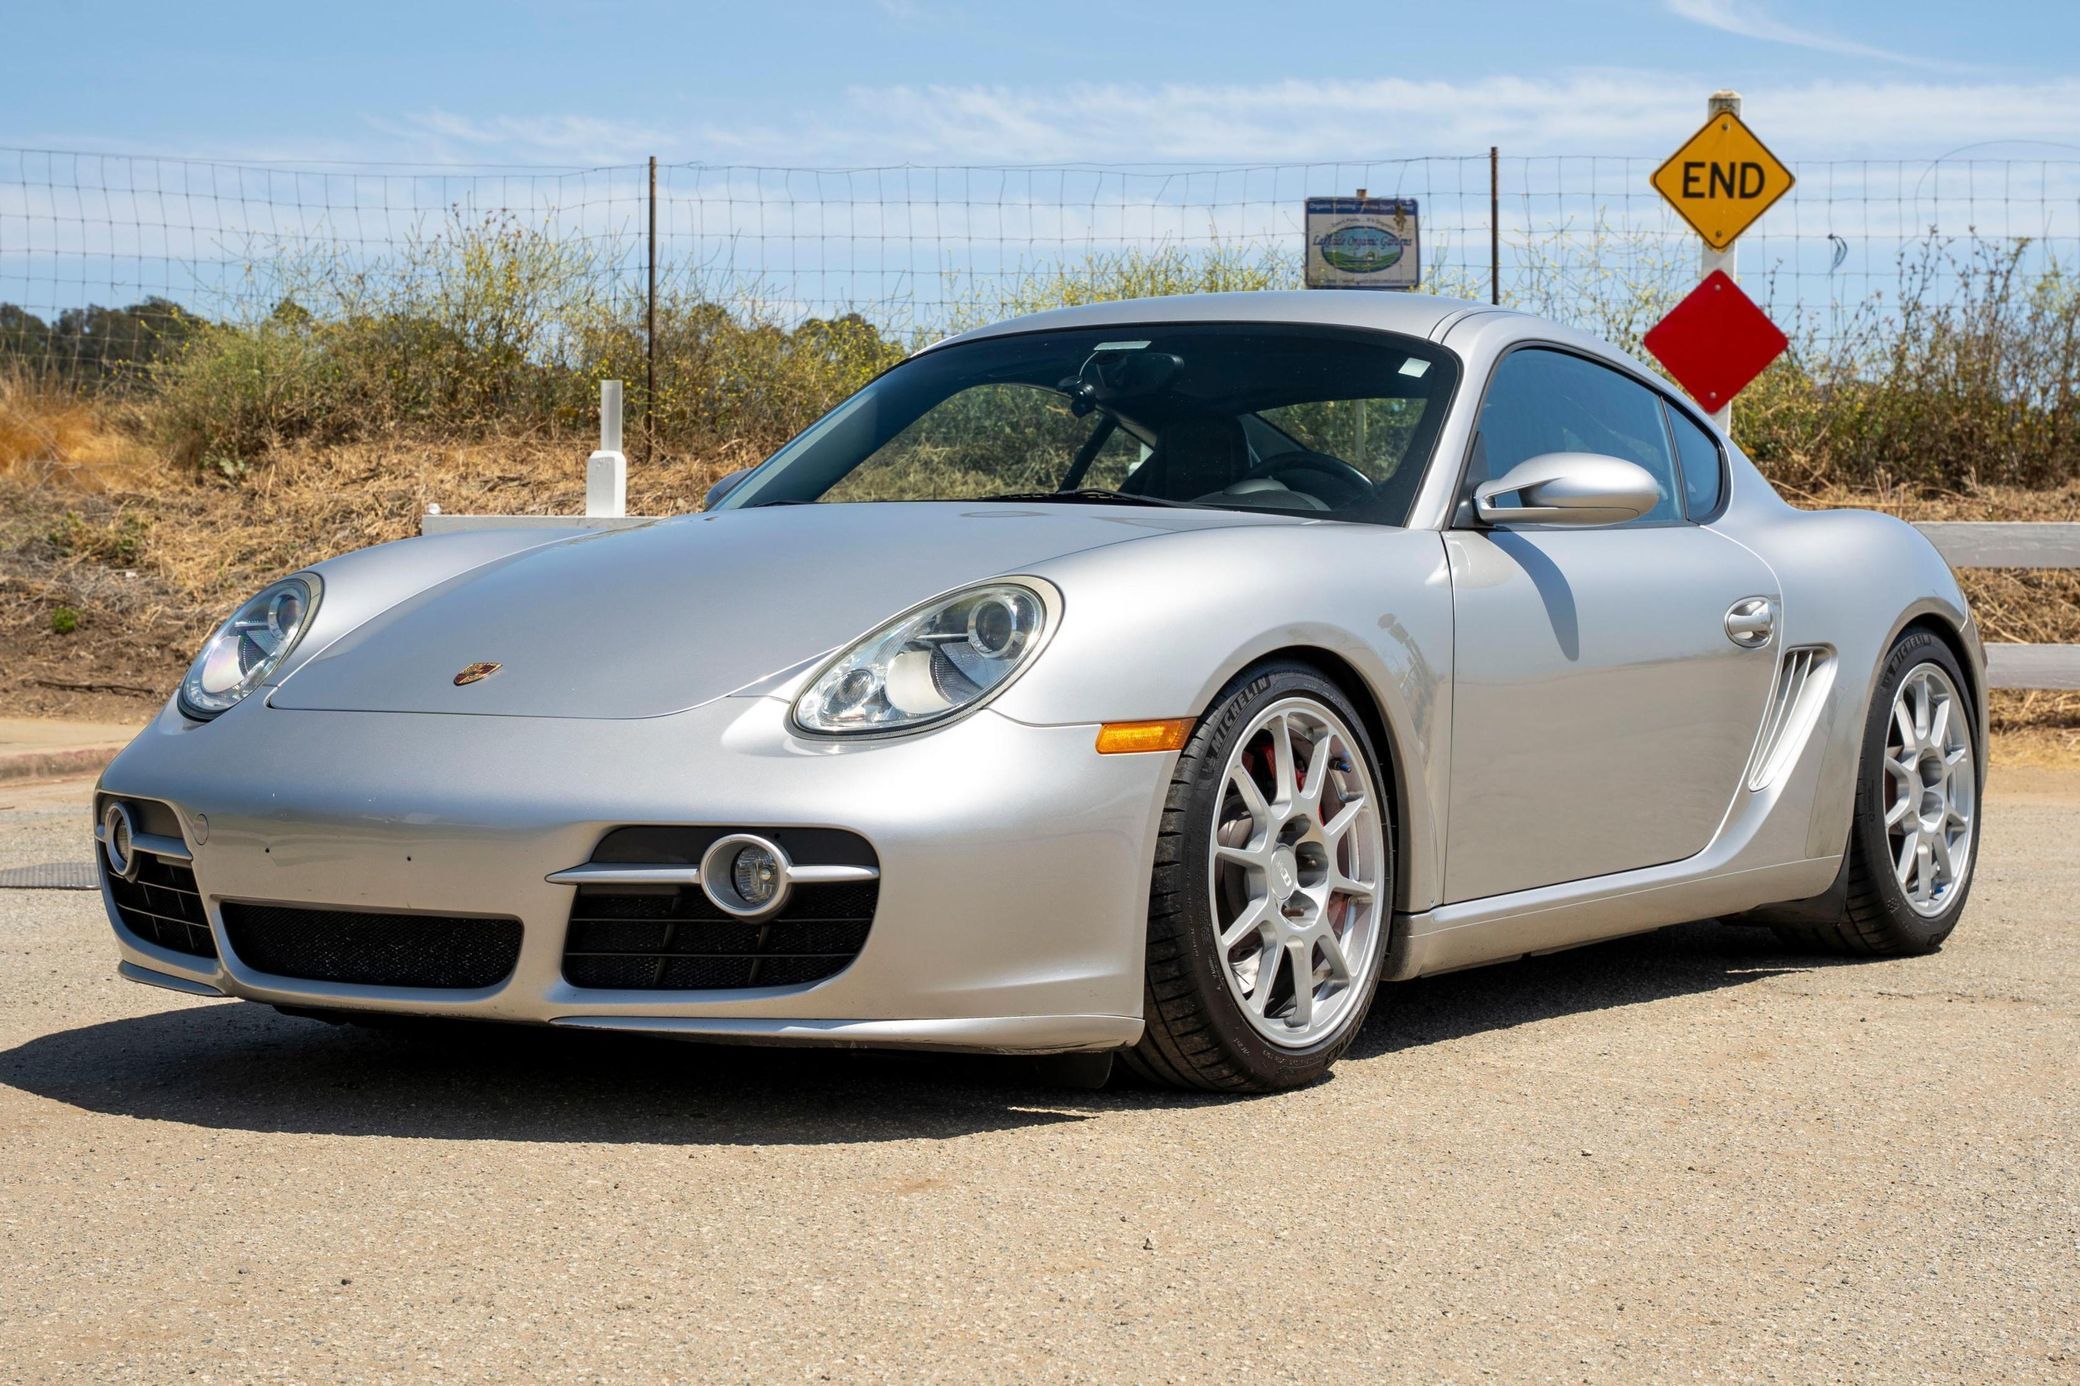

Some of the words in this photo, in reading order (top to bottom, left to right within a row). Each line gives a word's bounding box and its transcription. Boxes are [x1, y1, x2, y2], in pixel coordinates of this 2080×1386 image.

[1682, 161, 1765, 199] END
[1891, 633, 1931, 672] MICHELIN
[1210, 676, 1268, 754] MICHELIN
